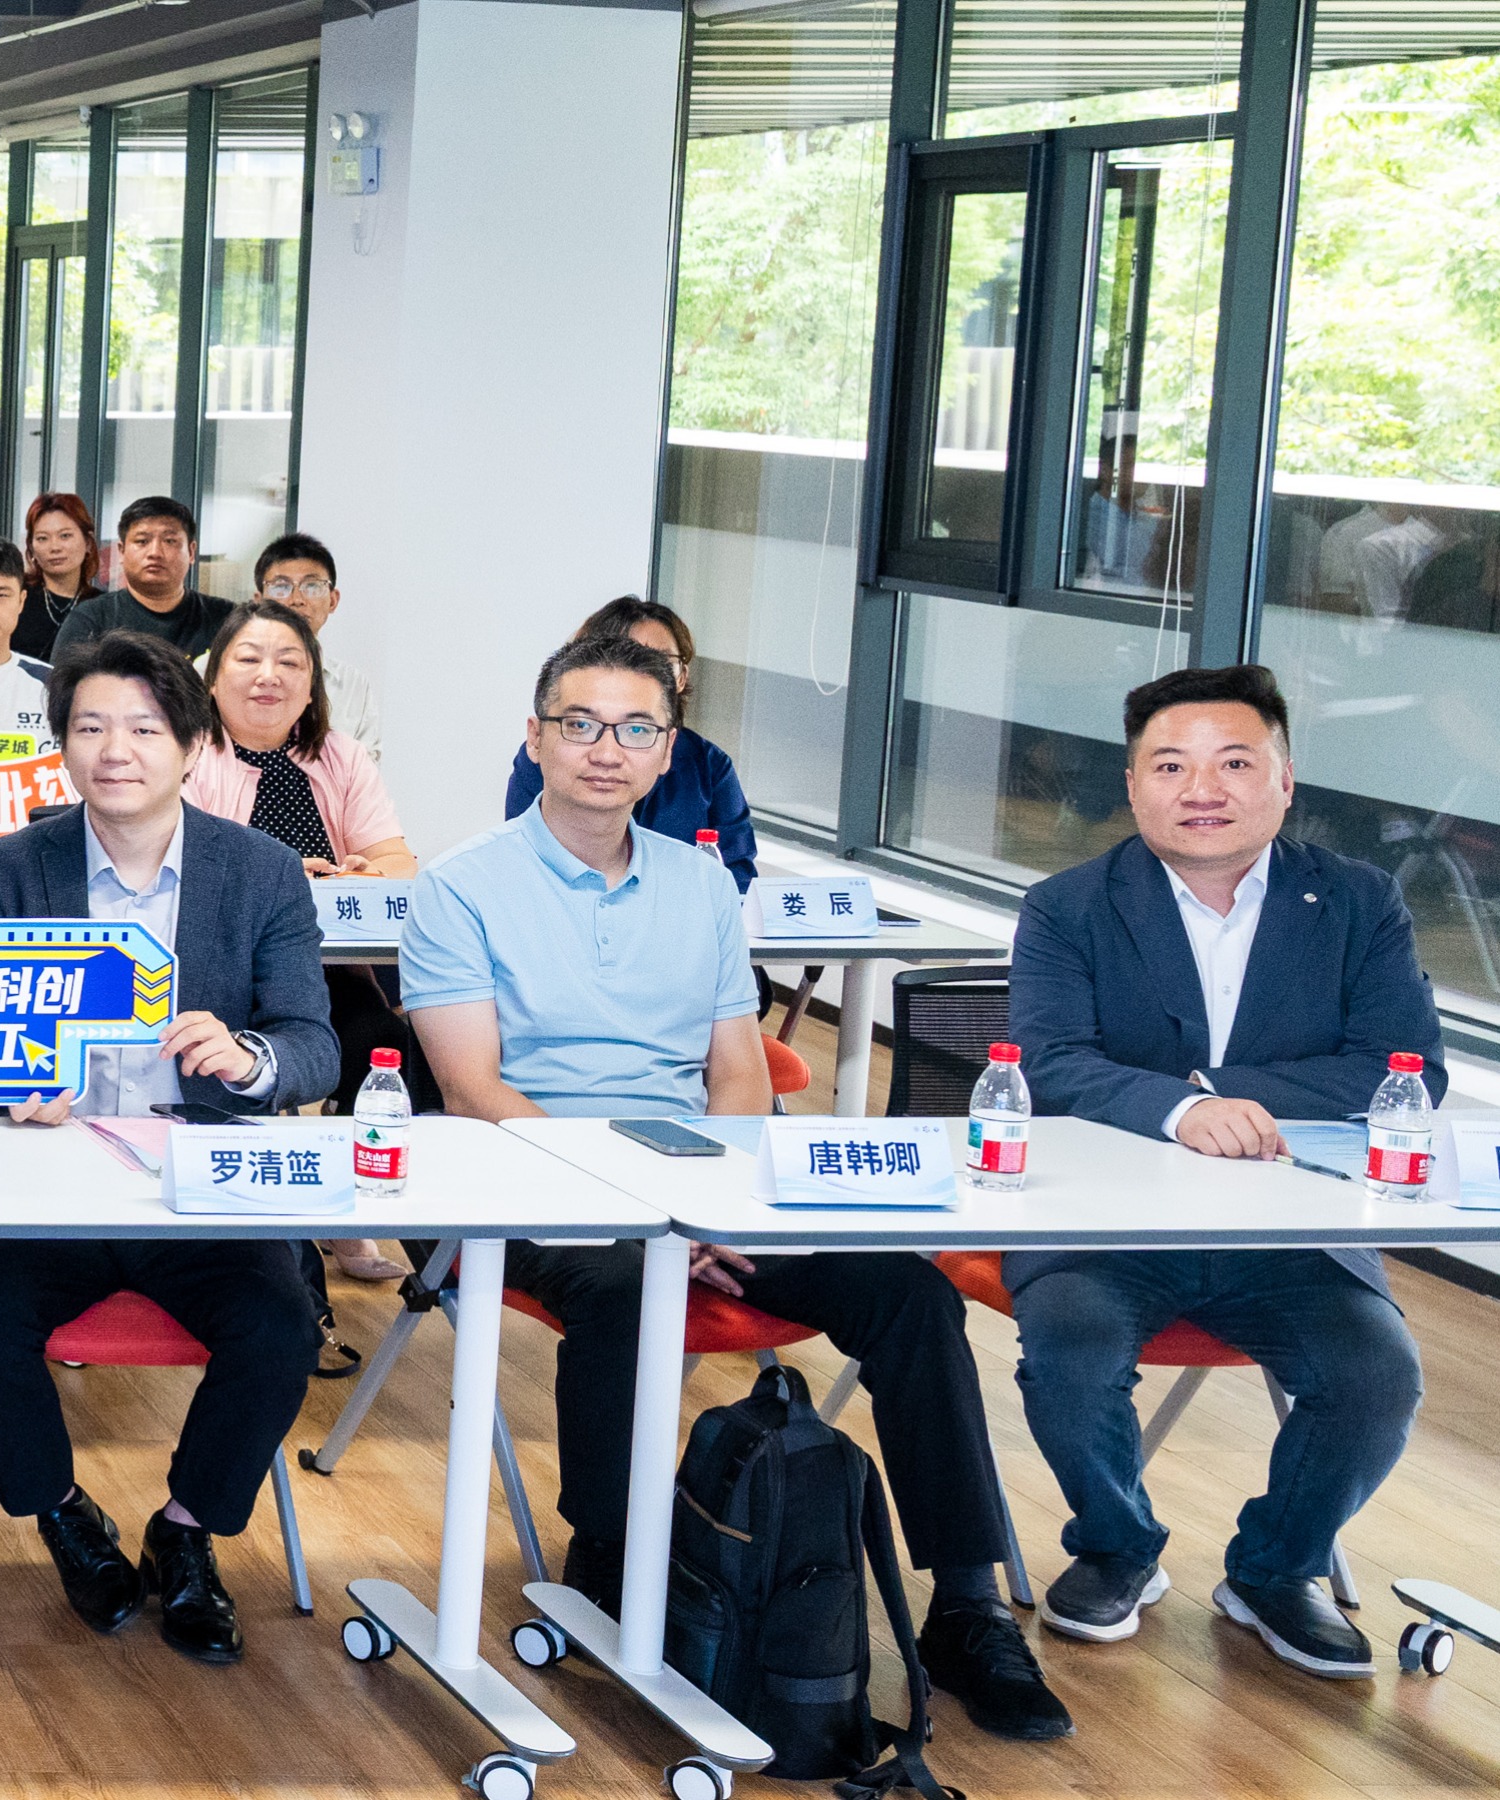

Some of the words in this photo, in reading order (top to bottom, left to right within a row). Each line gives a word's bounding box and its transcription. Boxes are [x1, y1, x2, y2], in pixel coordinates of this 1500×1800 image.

[335, 895, 362, 920] 姚
[385, 895, 408, 920] 旭
[781, 892, 806, 917] 娄
[829, 892, 853, 916] 辰
[210, 1149, 323, 1186] 罗清篮
[808, 1140, 921, 1176] 唐韩卿
